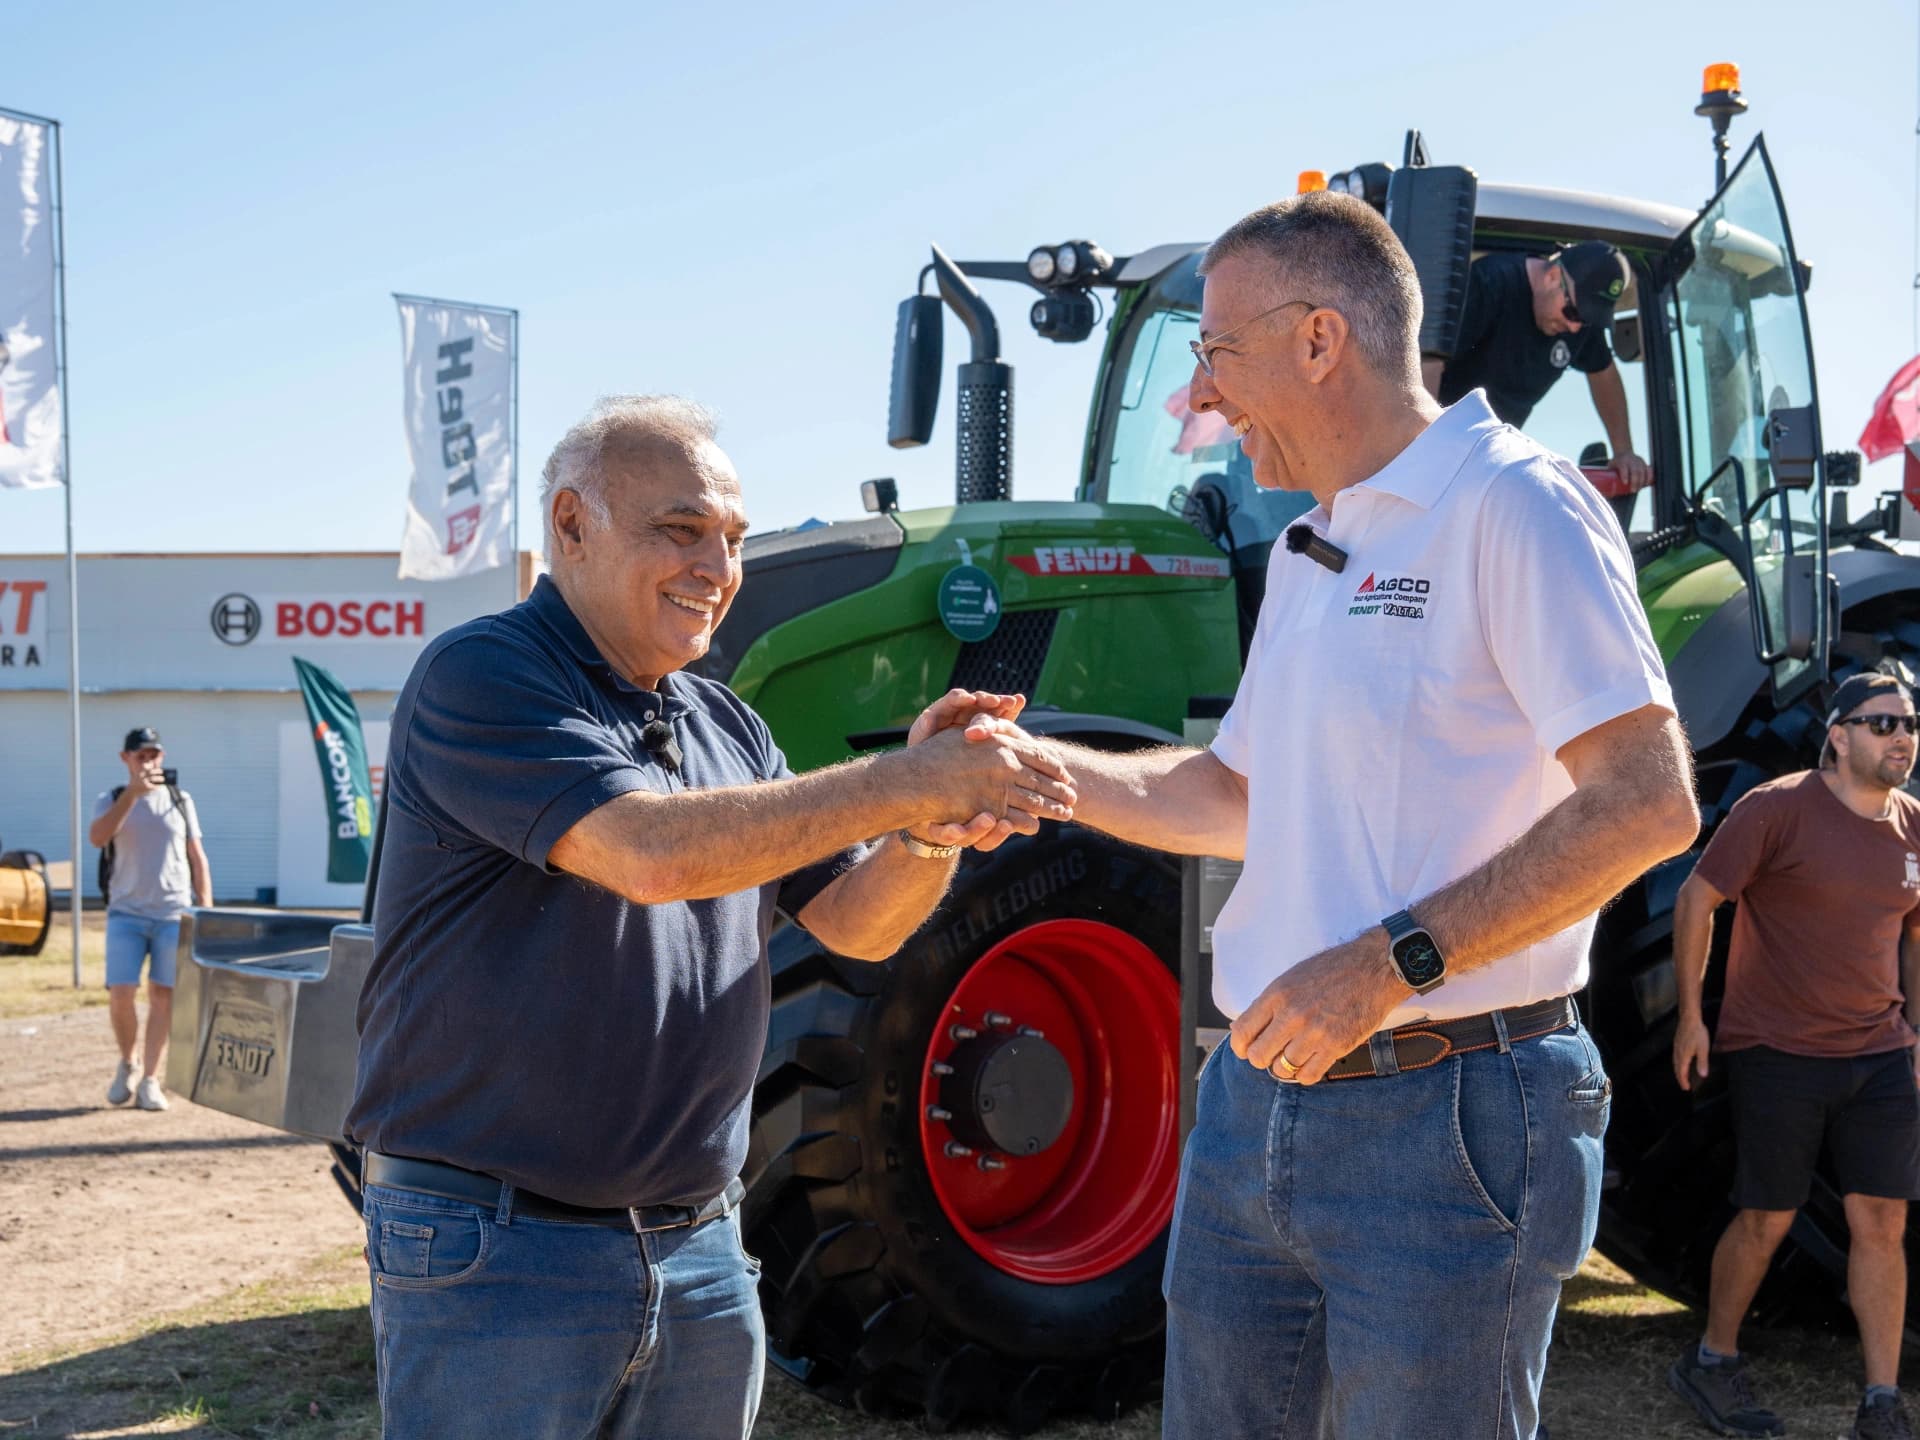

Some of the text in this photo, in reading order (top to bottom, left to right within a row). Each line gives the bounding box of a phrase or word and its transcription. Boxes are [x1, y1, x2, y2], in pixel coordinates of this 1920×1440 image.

[1034, 547, 1136, 572] FENDT
[1167, 557, 1192, 575] 728
[1375, 577, 1430, 594] AGCO
[1393, 593, 1428, 605] Company
[0, 581, 47, 635] T
[276, 601, 424, 638] BOSCH
[1348, 603, 1424, 619] FENDT VALTRA
[323, 729, 359, 838] BANCOR
[915, 847, 1088, 973] TRELLEBORG
[215, 1035, 275, 1077] FENDT
